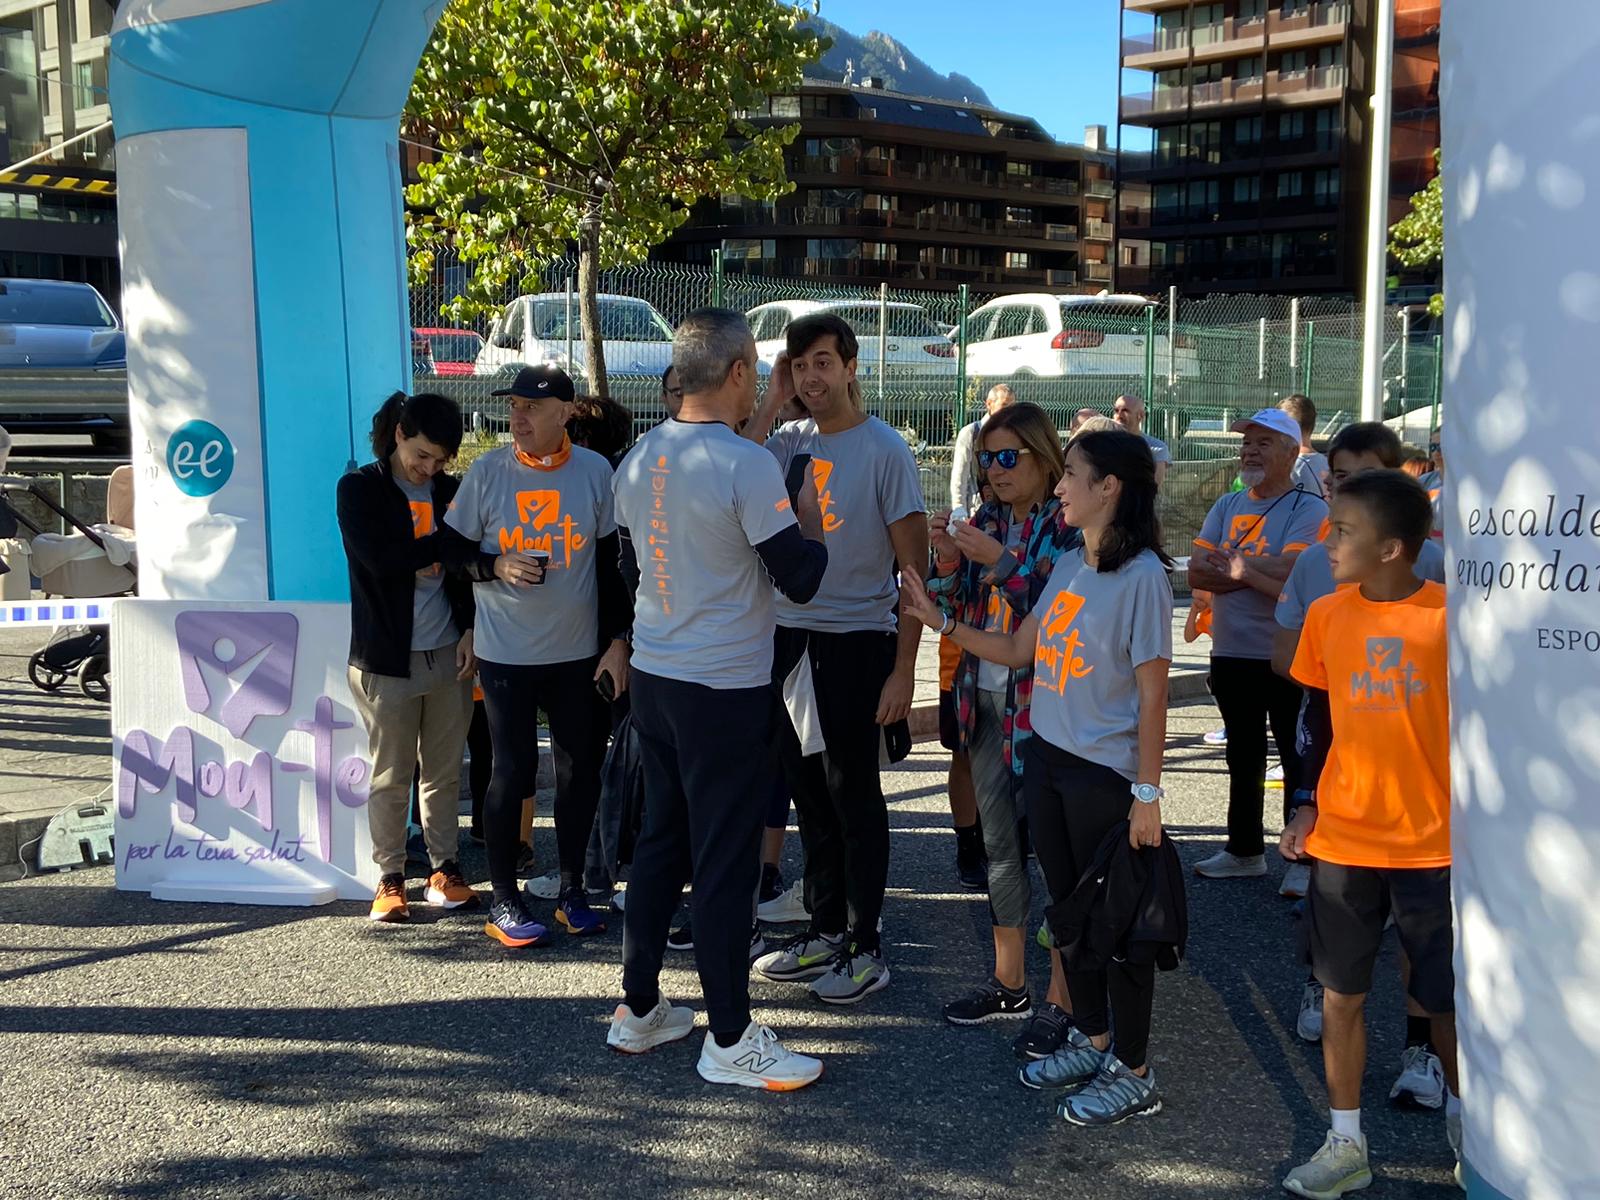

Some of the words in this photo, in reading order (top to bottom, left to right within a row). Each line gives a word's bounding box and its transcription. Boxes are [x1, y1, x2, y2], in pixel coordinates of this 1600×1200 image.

[1035, 628, 1094, 697] ou-te
[1537, 628, 1600, 652] ESPO
[118, 695, 370, 863] Mou-te
[124, 843, 161, 873] per
[164, 825, 190, 859] la
[244, 829, 316, 866] salut
